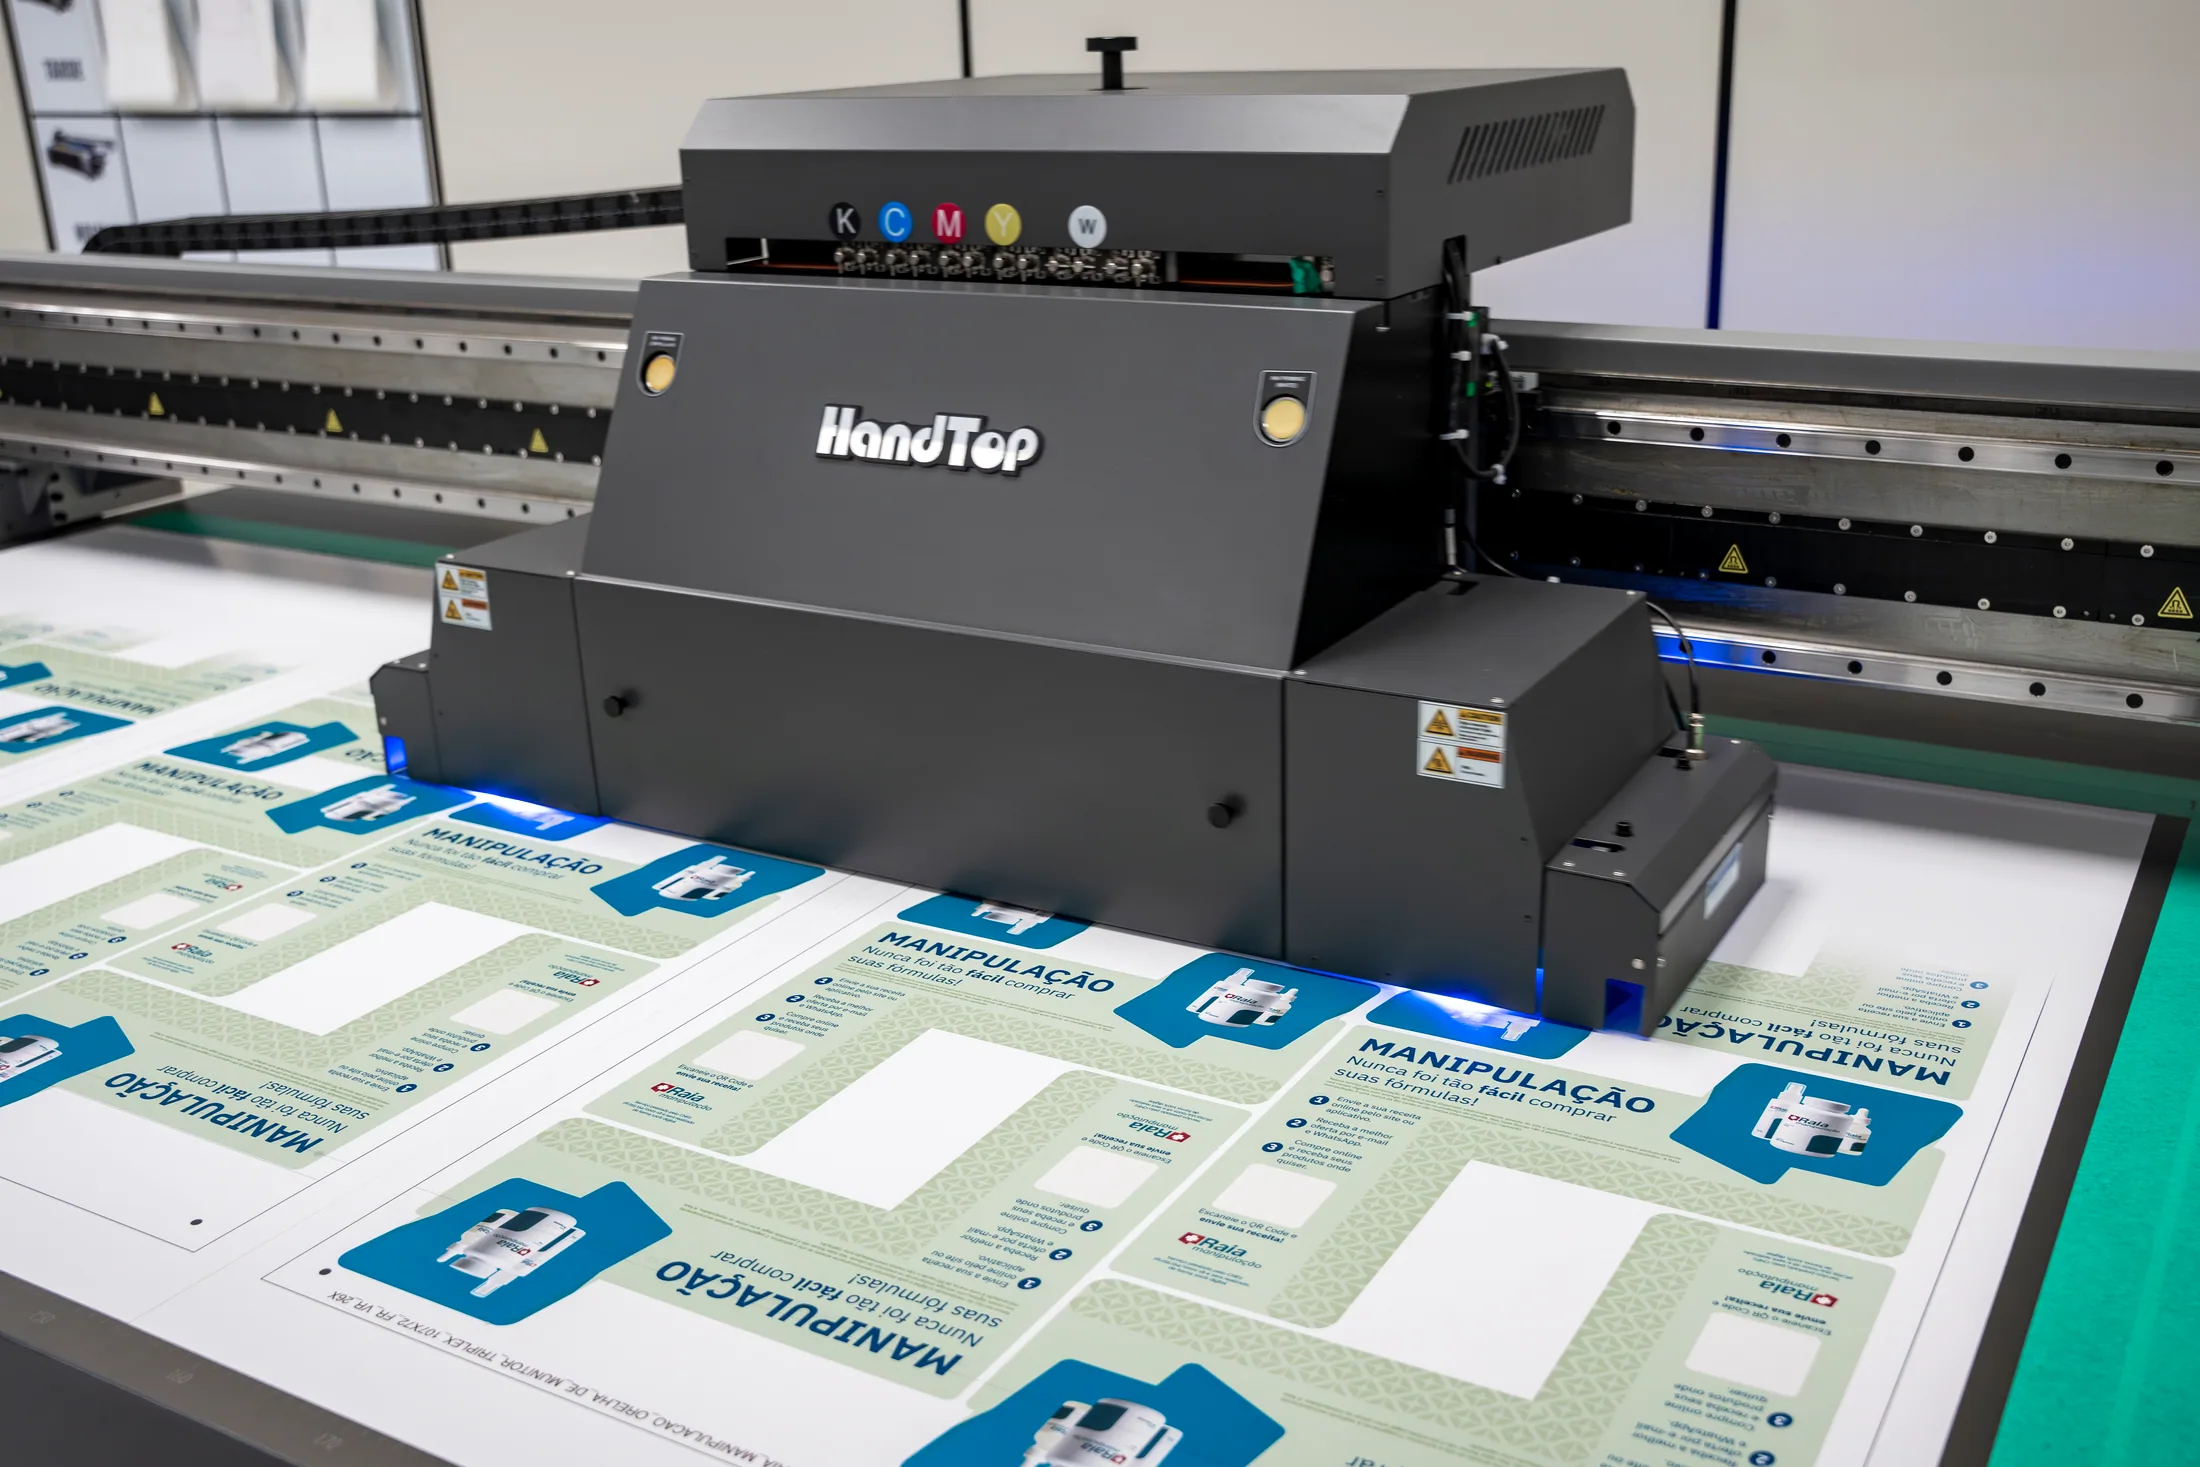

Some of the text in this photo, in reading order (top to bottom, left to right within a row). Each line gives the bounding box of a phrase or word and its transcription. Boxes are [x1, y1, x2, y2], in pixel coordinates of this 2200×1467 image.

[836, 208, 857, 234] K
[885, 207, 905, 237] C
[936, 209, 962, 238] M
[993, 211, 1014, 237] Y
[815, 405, 1040, 472] HandTop
[848, 956, 963, 986] suas fórmulas!
[878, 932, 1114, 992] MANIPULAÇÃO
[553, 971, 586, 984] Raia
[862, 946, 1075, 999] Nunca foi tão fácil comprar
[806, 999, 829, 1007] oferta
[842, 1008, 868, 1017] e-mail
[813, 994, 840, 1004] Receba
[846, 1003, 874, 1012] melhor
[1233, 995, 1258, 1004] Raia
[805, 1004, 843, 1018] WhatsApp.
[1904, 1006, 1950, 1017] aplicativo.
[1679, 1006, 1956, 1067] Nunca foi tão fácil comprar
[1810, 1019, 1962, 1054] suas fórmulas!
[1359, 1038, 1655, 1113] MANIPULAÇÃO
[666, 1086, 705, 1102] Raia
[1334, 1068, 1479, 1106] suas fórmulas!
[1346, 1056, 1617, 1122] Nunca foi tão fácil comprar
[156, 1066, 348, 1134] Nunca foi tão fácil comprar
[258, 1081, 370, 1120] suas fórmulas!
[658, 1094, 712, 1111] manipulação
[1331, 1102, 1360, 1112] online
[1360, 1110, 1382, 1118] pelo
[1336, 1096, 1362, 1105] Envie
[1389, 1109, 1421, 1120] receita
[104, 1073, 324, 1154] MANIPULAÇÃO
[1116, 1112, 1179, 1130] manipulação
[1325, 1108, 1371, 1122] aplicativo.
[1798, 1116, 1829, 1128] Raia
[1129, 1122, 1172, 1138] Raia
[1310, 1124, 1338, 1134] oferta
[1357, 1135, 1389, 1146] e-mail
[1313, 1130, 1362, 1146] WhatsApp.
[1316, 1117, 1350, 1130] Receba
[1360, 1128, 1393, 1139] melhor
[1294, 1140, 1362, 1160] Compre online
[1296, 1148, 1329, 1159] receba
[1330, 1156, 1352, 1165] seus
[1276, 1158, 1307, 1170] quiser.
[1281, 1152, 1351, 1172] produtos onde
[1198, 1208, 1240, 1222] Escaneie
[1249, 1222, 1264, 1230] QR
[1265, 1226, 1290, 1236] Code
[1199, 1217, 1226, 1227] envie
[1246, 1230, 1284, 1243] receita!
[496, 1239, 521, 1254] Raia
[1198, 1237, 1247, 1257] Raia
[922, 1257, 955, 1270] receita
[931, 1250, 1017, 1280] online pelo site ou
[978, 1255, 1026, 1272] aplicativo.
[1192, 1246, 1262, 1268] manipulação
[955, 1268, 974, 1276] sua
[982, 1276, 1009, 1288] Envie
[710, 1251, 984, 1348] Nunca foi tão fácil comprar
[847, 1273, 1002, 1327] suas fórmulas!
[1759, 1280, 1813, 1301] Raia
[656, 1261, 963, 1376] MANIPULAÇÃO
[1722, 1303, 1750, 1314] Code
[1724, 1296, 1826, 1324] envie sua receita!
[1752, 1311, 1769, 1319] QR
[1781, 1319, 1832, 1336] Escaneie
[1729, 1388, 1768, 1403] quiser.
[1081, 1442, 1115, 1460] Raia
